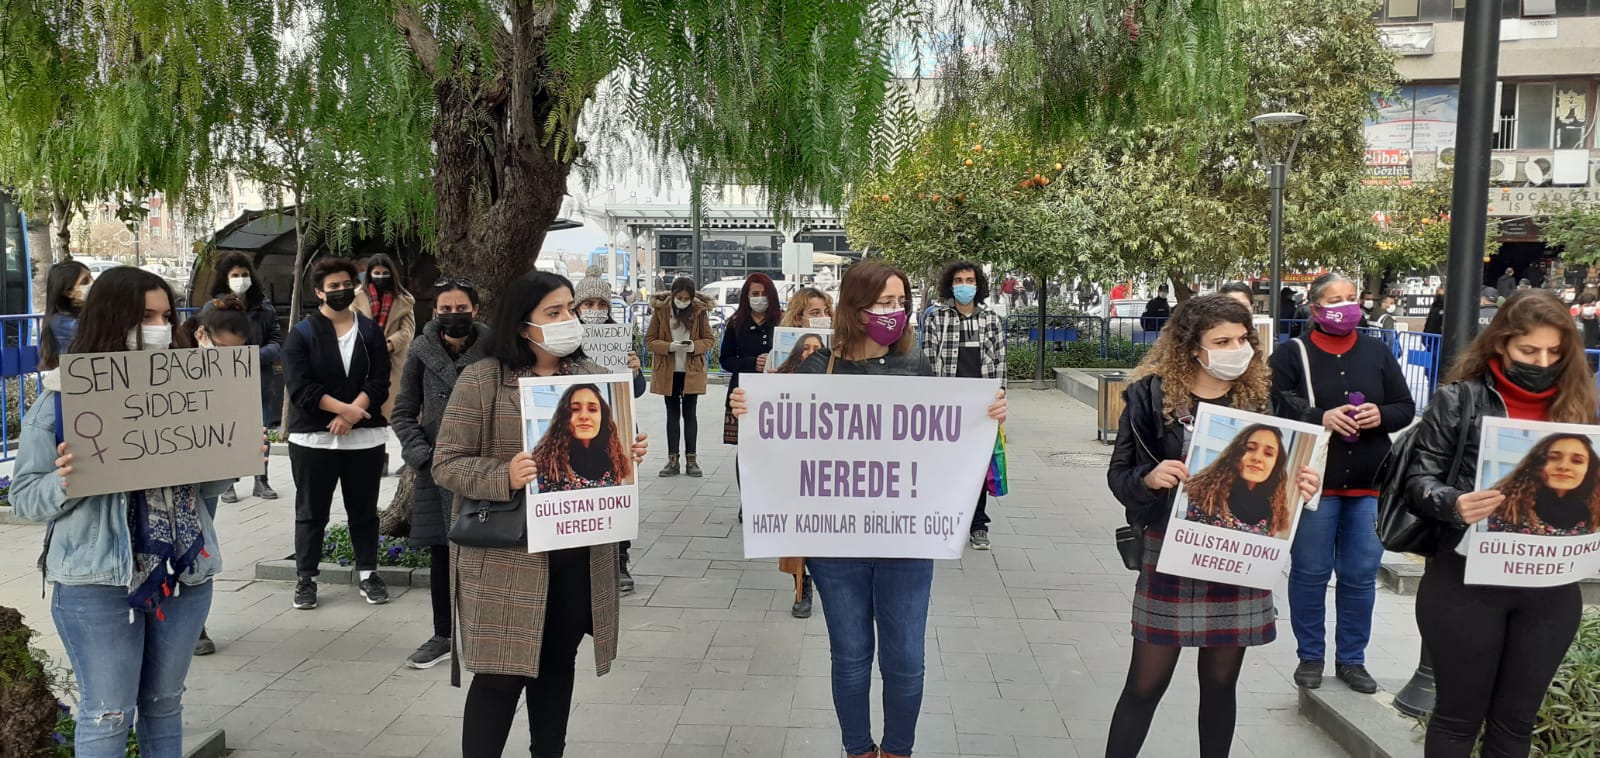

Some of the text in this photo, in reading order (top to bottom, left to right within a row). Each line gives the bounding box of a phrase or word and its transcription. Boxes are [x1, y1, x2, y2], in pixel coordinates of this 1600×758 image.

[66, 356, 130, 394] SEN
[150, 348, 223, 386] BAĞIR
[122, 389, 214, 421] ŞİDDET
[759, 393, 962, 442] GÜLİSTAN DOKU
[119, 421, 237, 461] SUSSUN!
[800, 459, 918, 498] NEREDE !
[535, 495, 631, 518] GÜLİSTAN DOKU
[556, 516, 612, 535] NEREDE !
[753, 513, 789, 534] HATAY
[795, 513, 856, 534] KADINLAR
[863, 510, 917, 534] BİRLİKTE
[1175, 528, 1280, 561] GÜLİSTAN DOKU
[1479, 538, 1600, 557] GÜLİSTAN DOKU
[1191, 553, 1252, 575] NEREDE !
[1503, 561, 1574, 575] NEREDE !
